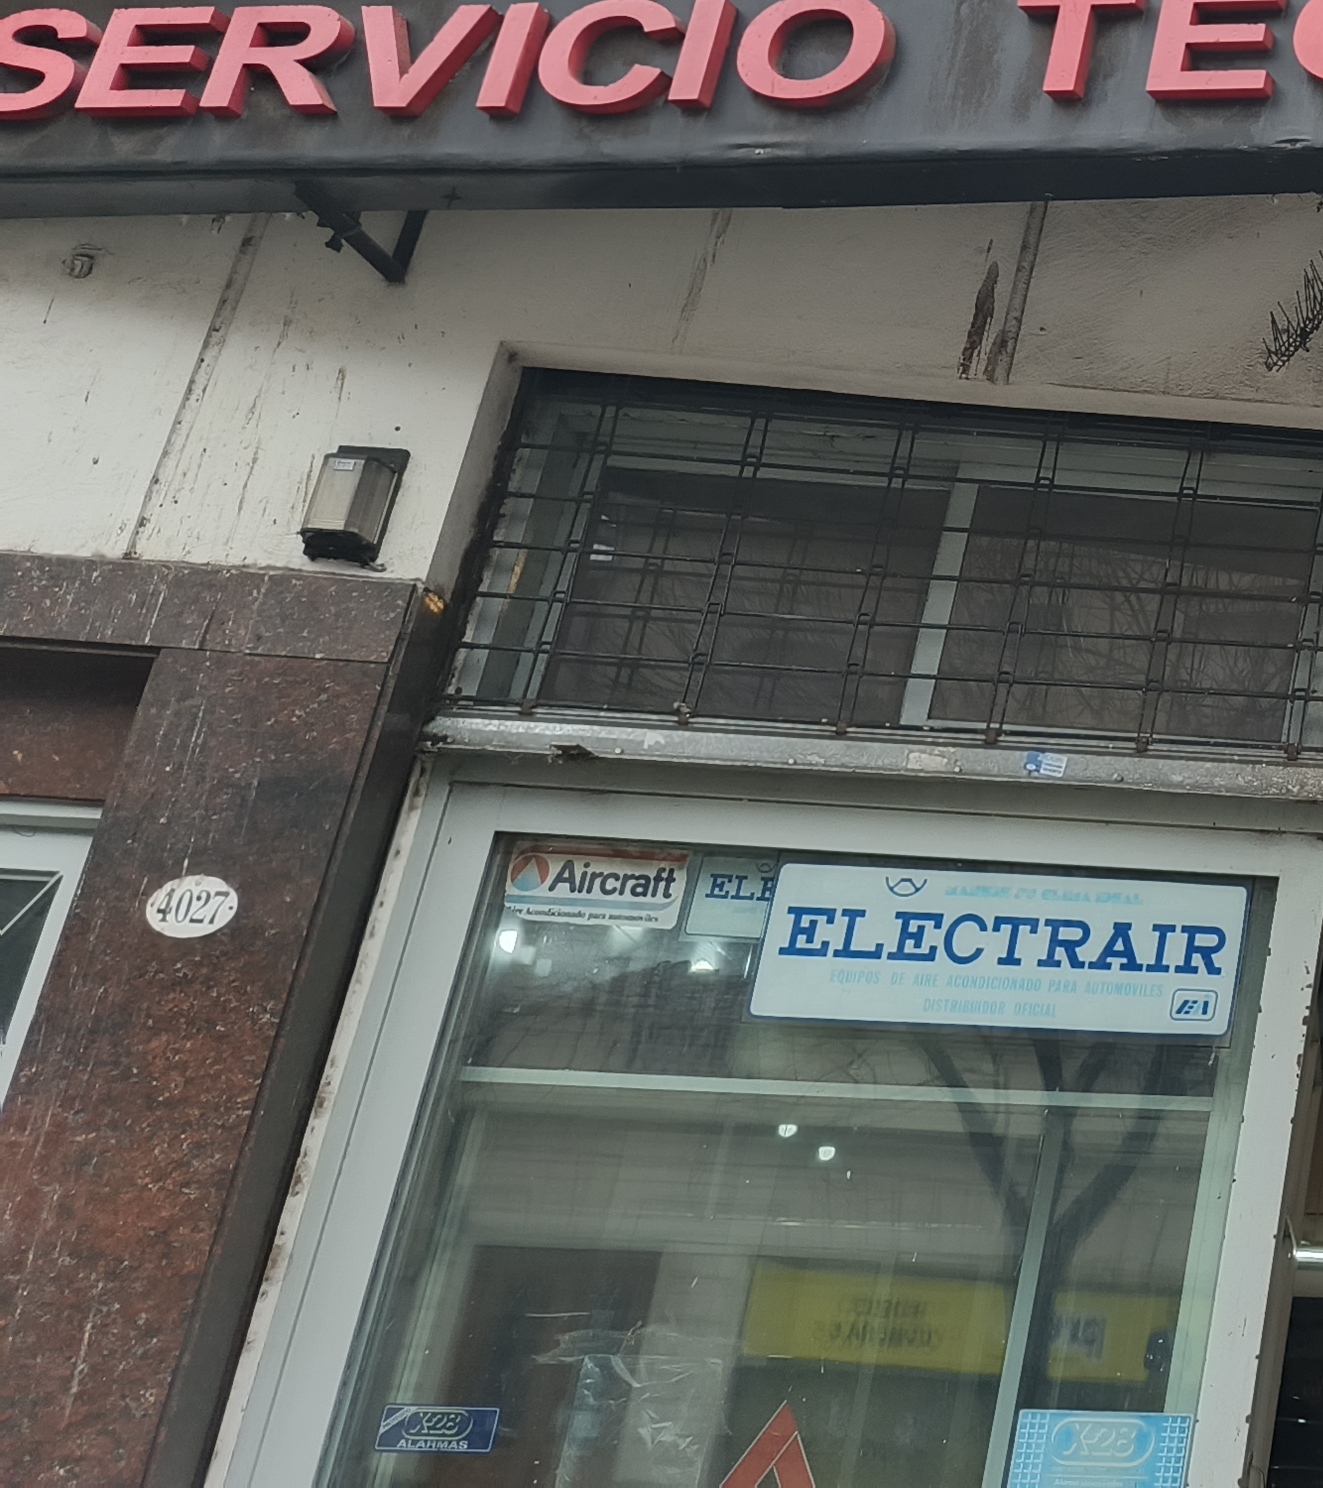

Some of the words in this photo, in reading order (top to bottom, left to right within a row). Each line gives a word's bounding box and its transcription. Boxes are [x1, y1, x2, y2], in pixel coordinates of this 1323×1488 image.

[548, 858, 677, 900] Aircraft
[156, 887, 231, 926] 4027
[777, 906, 1228, 976] ELECTRAIR
[829, 968, 882, 985] EQUIPOS
[890, 971, 907, 986] DE
[912, 973, 939, 988] AIRE
[945, 974, 1042, 993] ACONDICIONADO
[1048, 978, 1078, 994] PARA
[1083, 980, 1166, 999] AUTOMOVILES
[922, 997, 1007, 1016] DISTRIBUIDOR
[1013, 1001, 1057, 1019] OFICIAL
